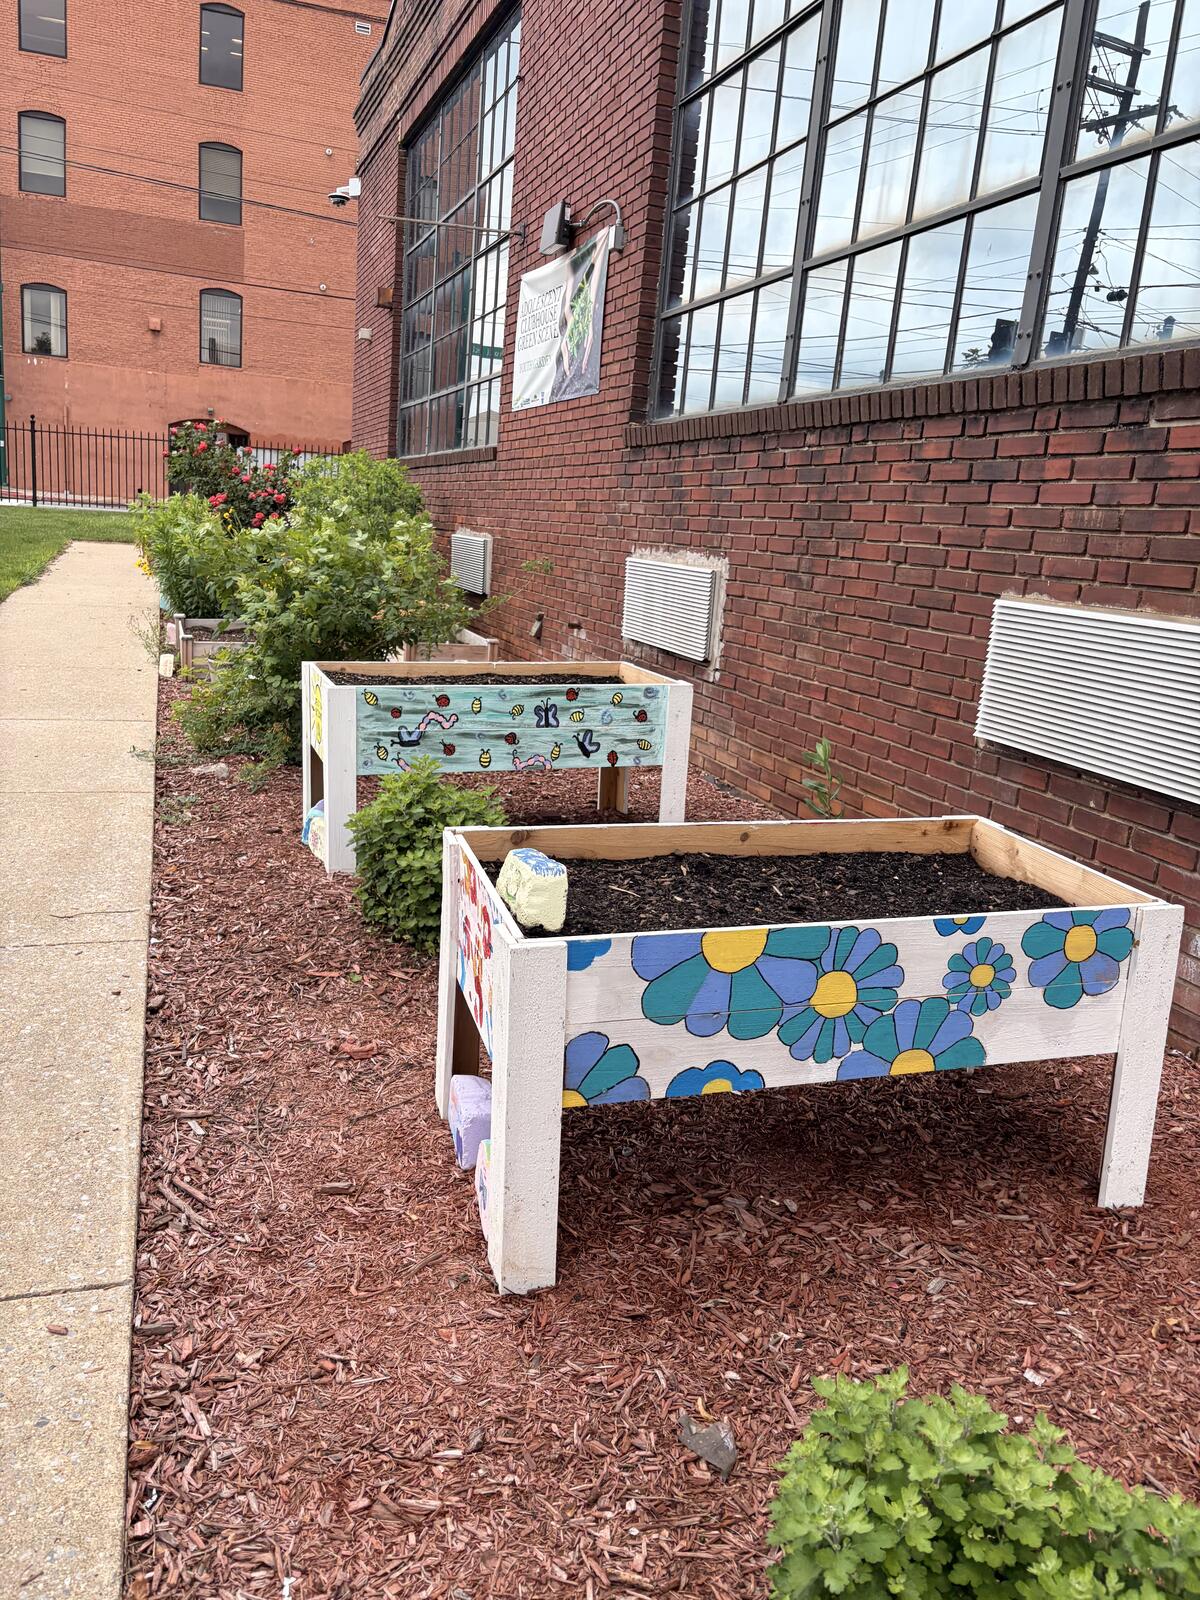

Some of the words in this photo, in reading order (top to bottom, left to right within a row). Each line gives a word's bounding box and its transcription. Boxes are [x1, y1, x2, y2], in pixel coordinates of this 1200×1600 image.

[520, 285, 563, 318] ADOLESCENT
[520, 304, 559, 335] CLUBHOUSE
[518, 330, 537, 352] GREEN
[537, 322, 559, 344] SCENE
[534, 354, 551, 369] GARDEN
